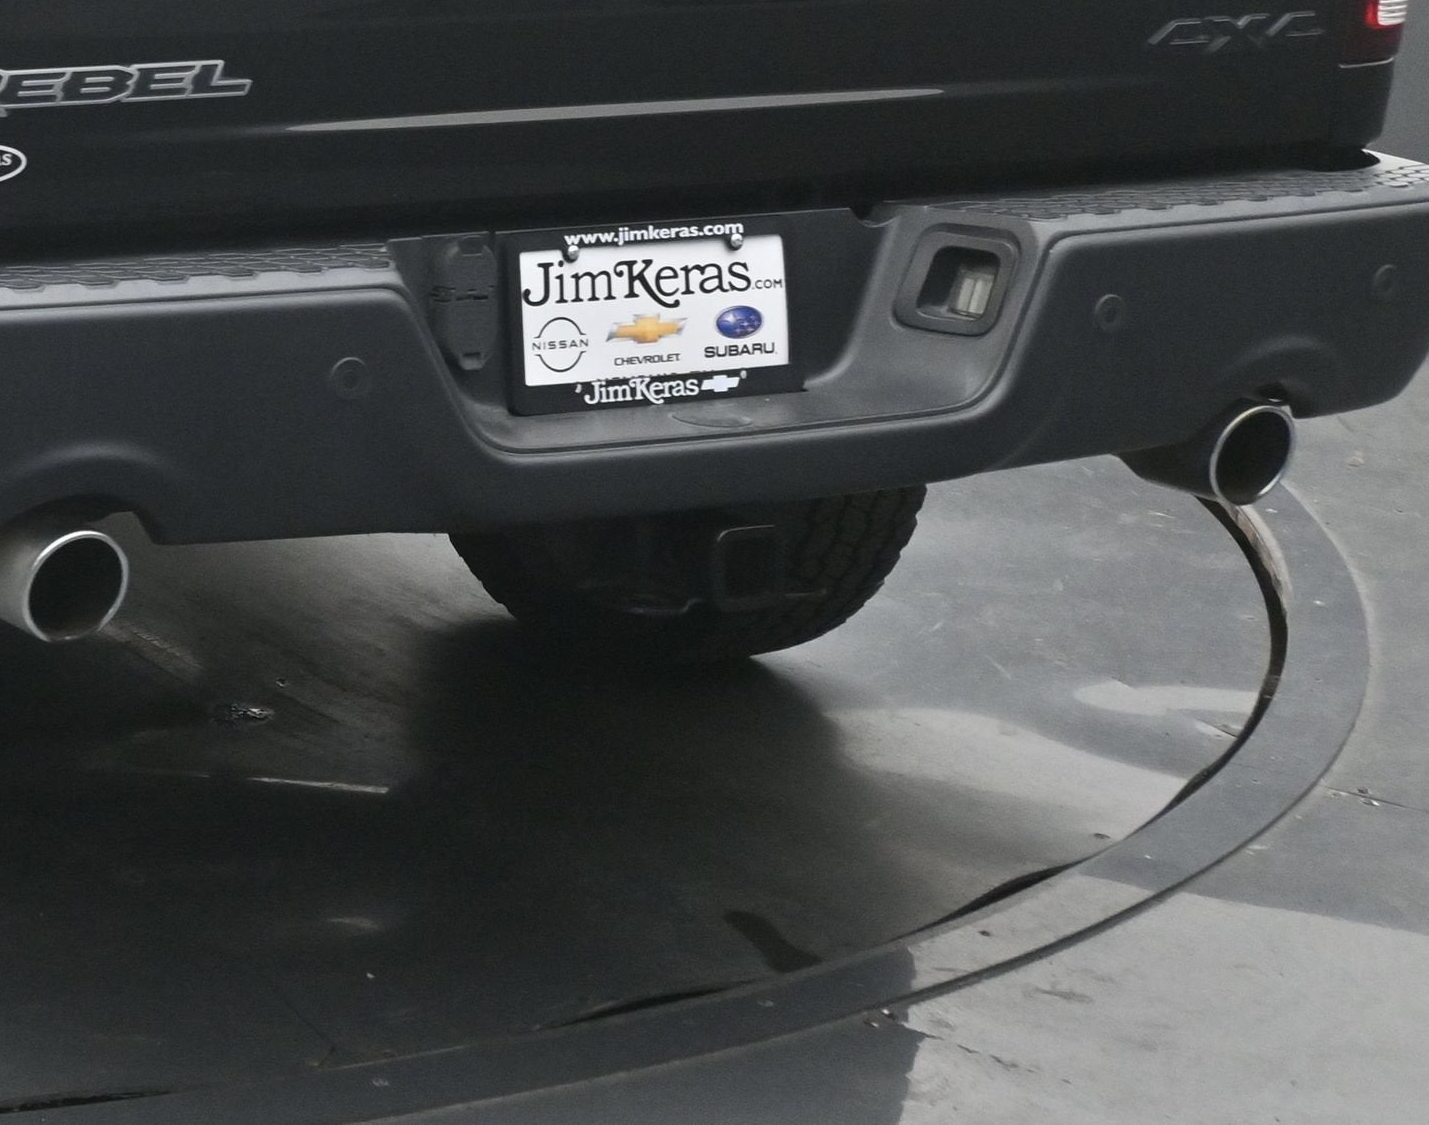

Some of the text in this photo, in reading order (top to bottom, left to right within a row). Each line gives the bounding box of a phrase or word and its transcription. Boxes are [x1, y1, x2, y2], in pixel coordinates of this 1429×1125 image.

[564, 222, 744, 245] www.jimkeras.com
[532, 338, 589, 350] NISSAN
[704, 342, 775, 358] SUBARU
[614, 353, 681, 366] CHEVROLET
